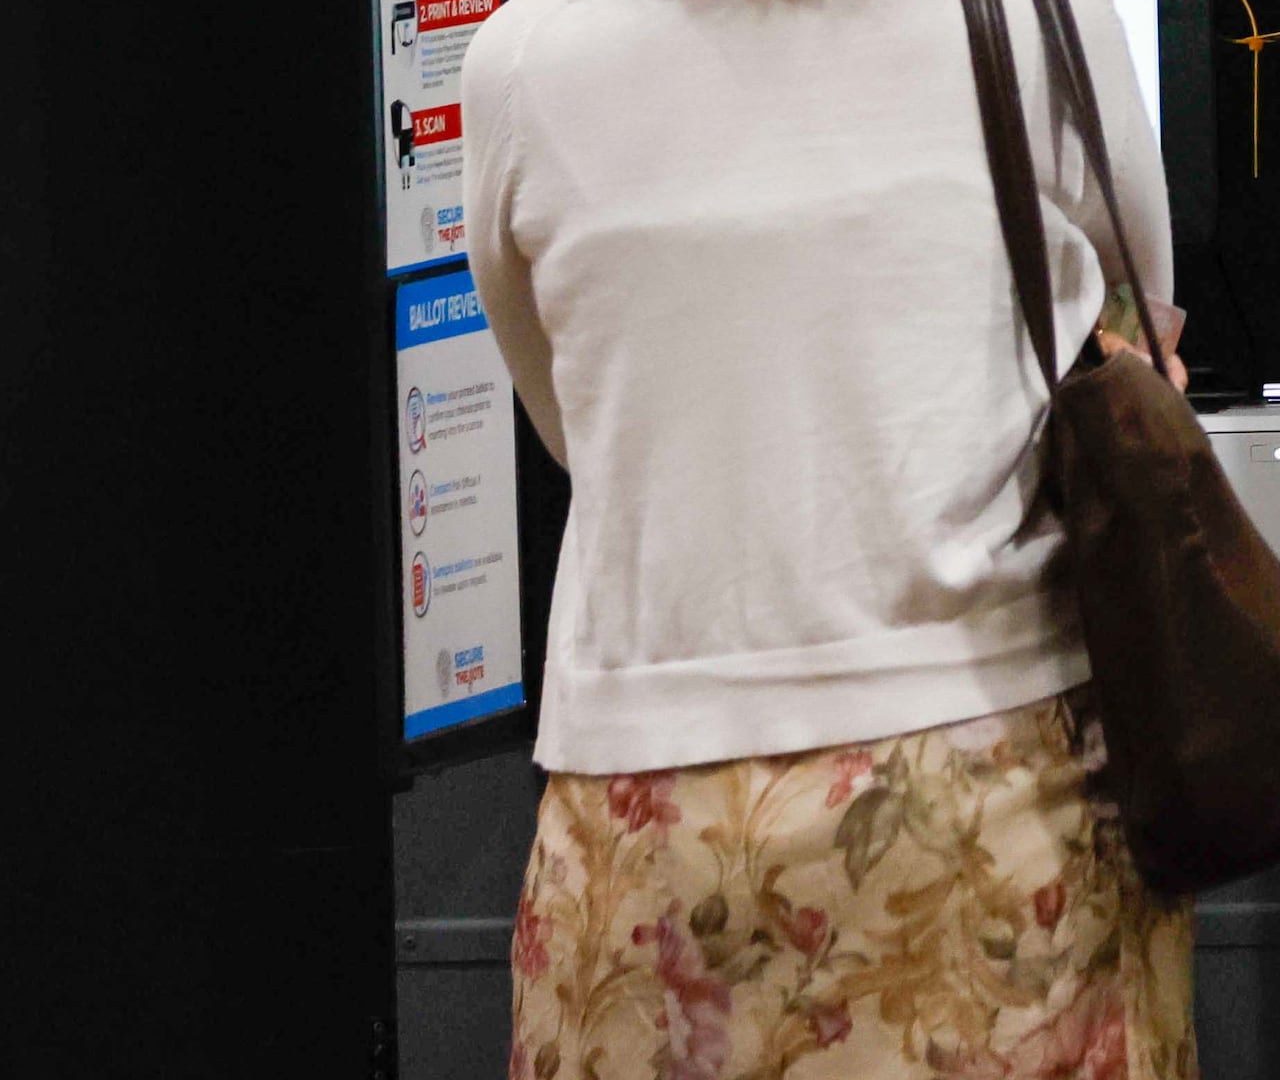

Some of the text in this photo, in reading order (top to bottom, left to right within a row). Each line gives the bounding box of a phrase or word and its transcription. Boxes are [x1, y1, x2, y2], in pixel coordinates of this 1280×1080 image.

[428, 0, 451, 21] PRINT
[422, 114, 446, 135] SCAN
[437, 205, 464, 225] SECUR
[410, 289, 481, 331] BALLOT REVIE
[455, 646, 484, 668] SECURE
